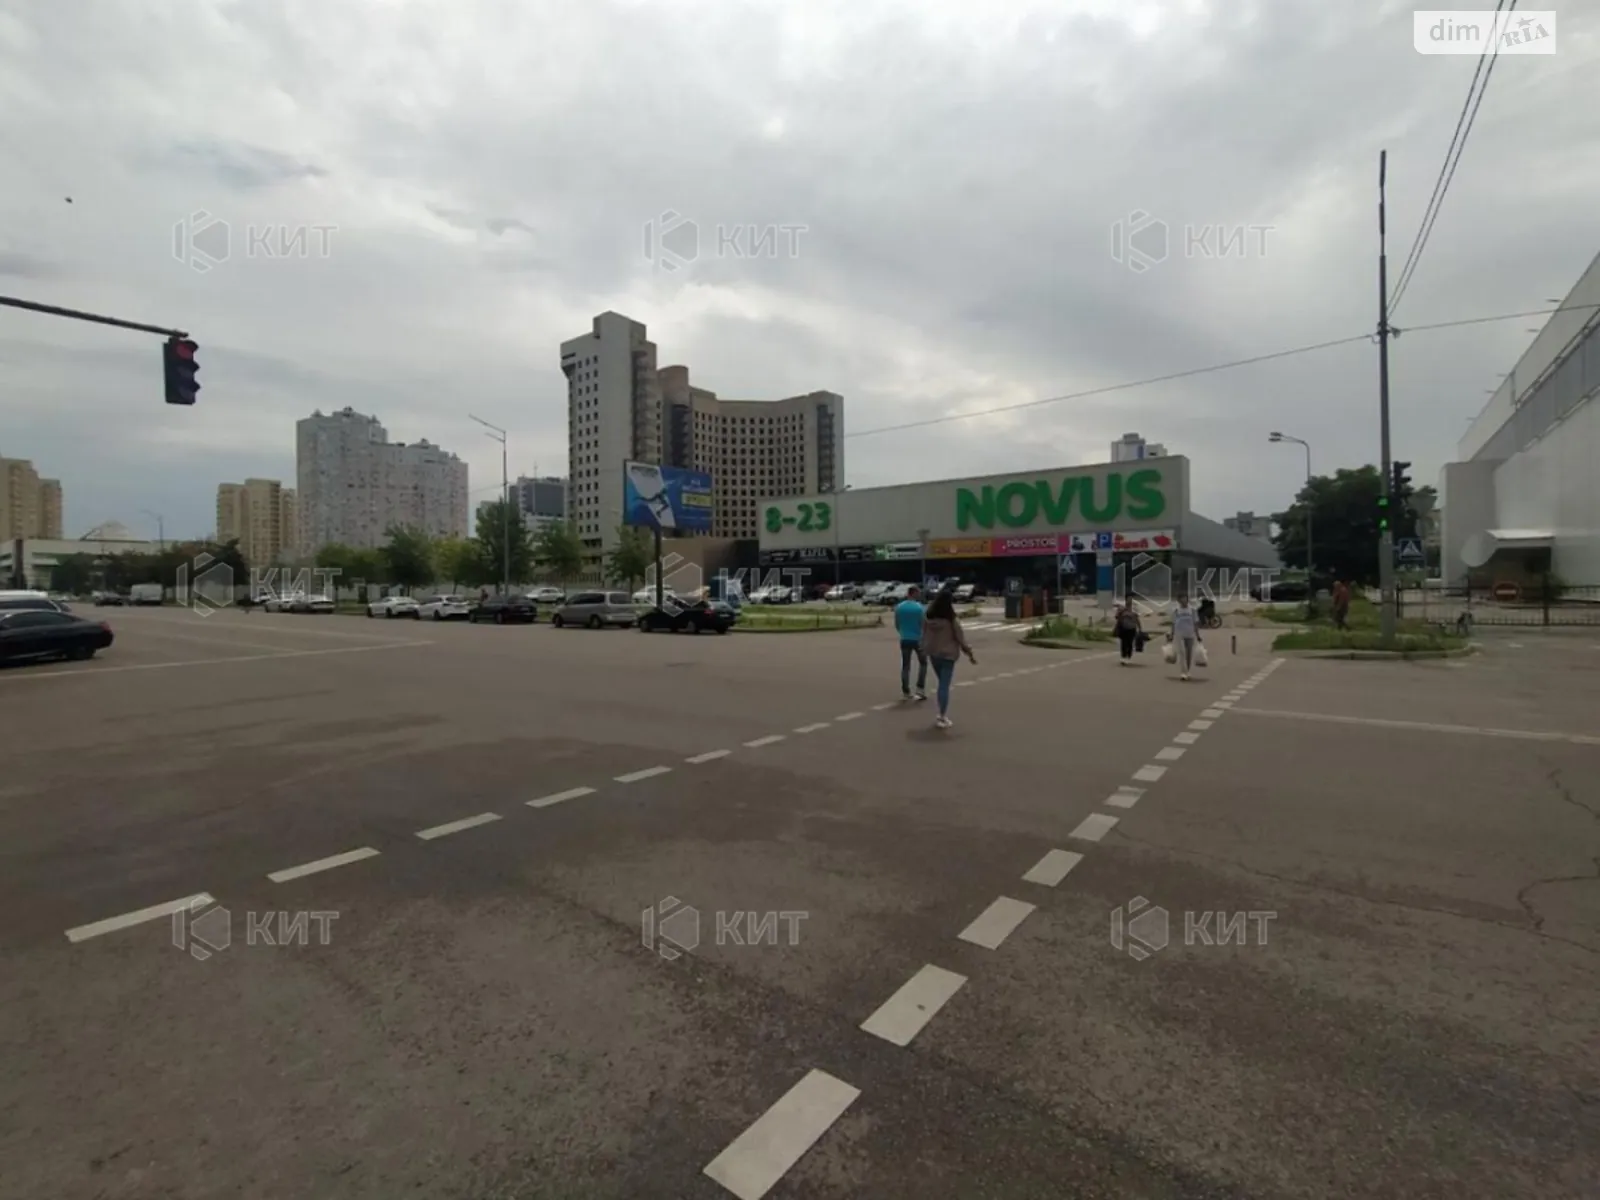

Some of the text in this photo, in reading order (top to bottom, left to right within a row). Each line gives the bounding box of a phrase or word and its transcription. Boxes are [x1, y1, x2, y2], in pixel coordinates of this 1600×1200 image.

[956, 468, 1166, 532] NOVUS
[765, 502, 831, 533] 8-23
[1006, 538, 1057, 549] PROSTOR
